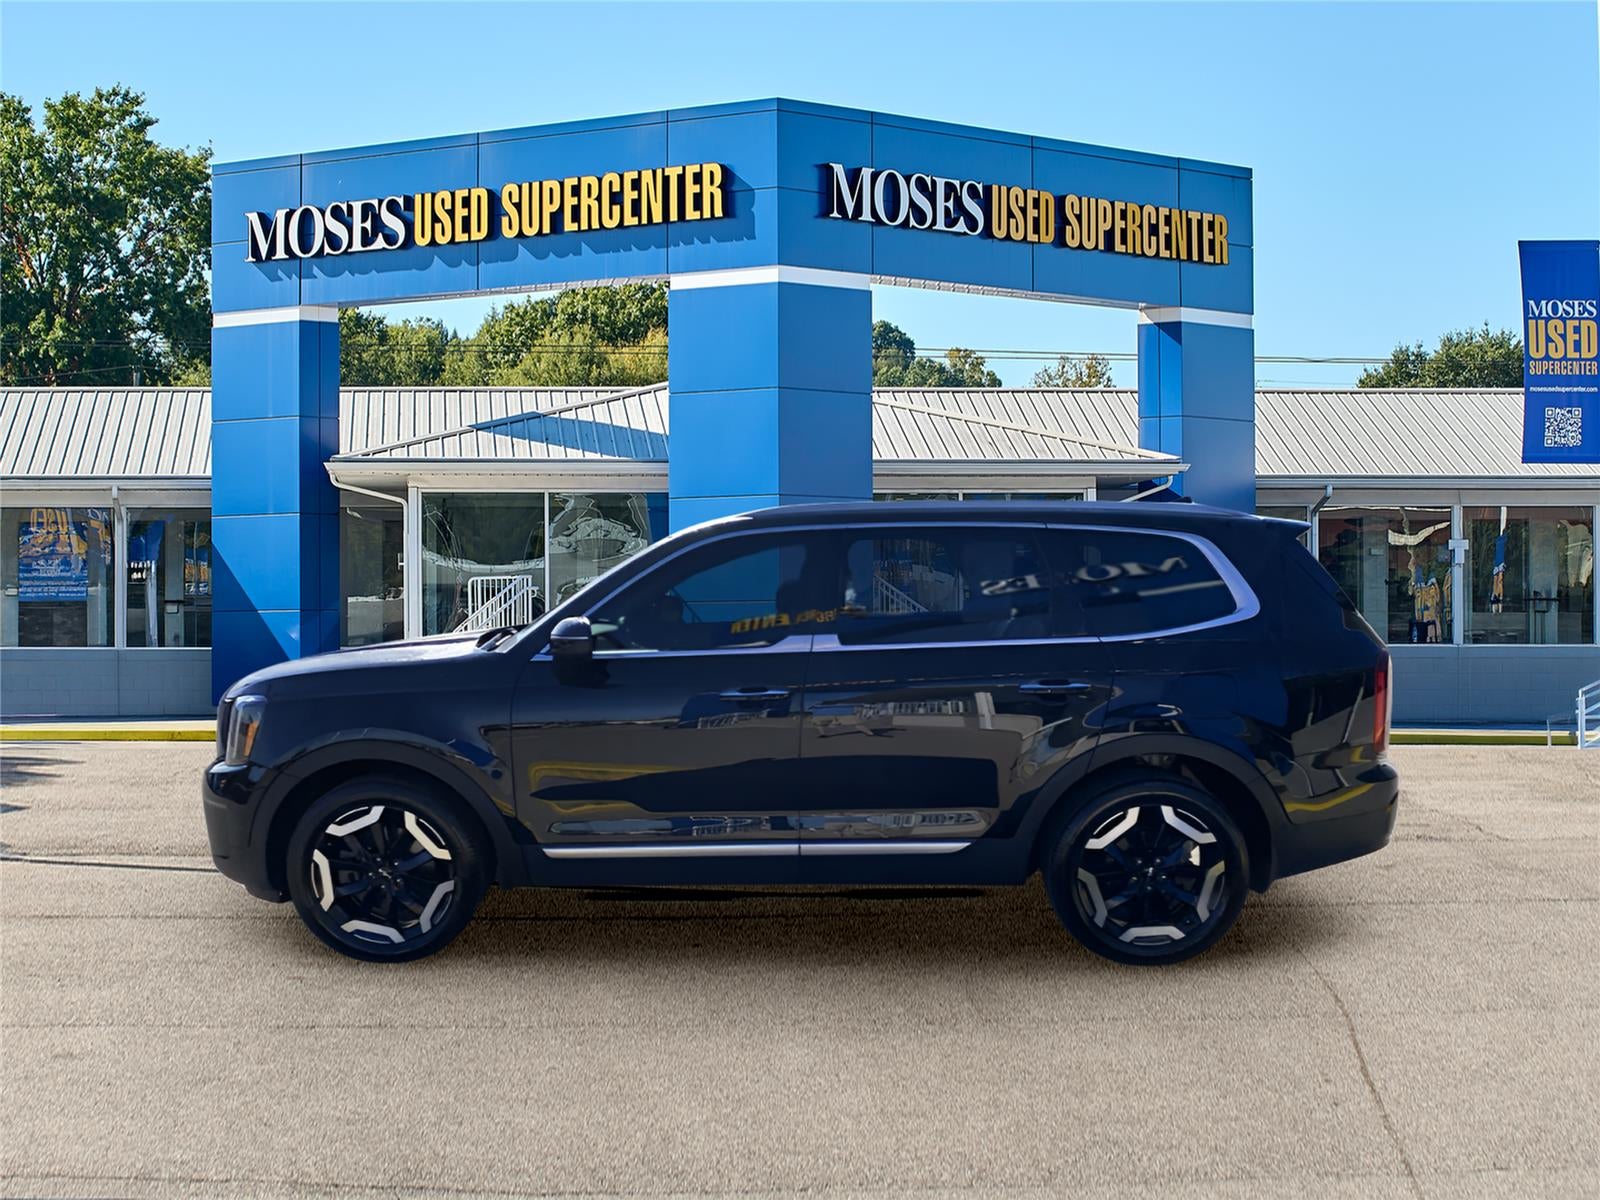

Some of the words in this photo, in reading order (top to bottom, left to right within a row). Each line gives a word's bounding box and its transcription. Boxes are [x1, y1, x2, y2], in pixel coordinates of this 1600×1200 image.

[244, 195, 408, 263] MOSES
[413, 187, 489, 247] USED
[501, 162, 724, 239] SUPERCENTER
[829, 162, 985, 236] MOSES
[991, 184, 1055, 244] USED
[1064, 193, 1230, 265] SUPERCENTER
[1528, 299, 1597, 318] MOSES
[1528, 319, 1598, 359] USED
[1529, 360, 1598, 375] SUPERCENTER
